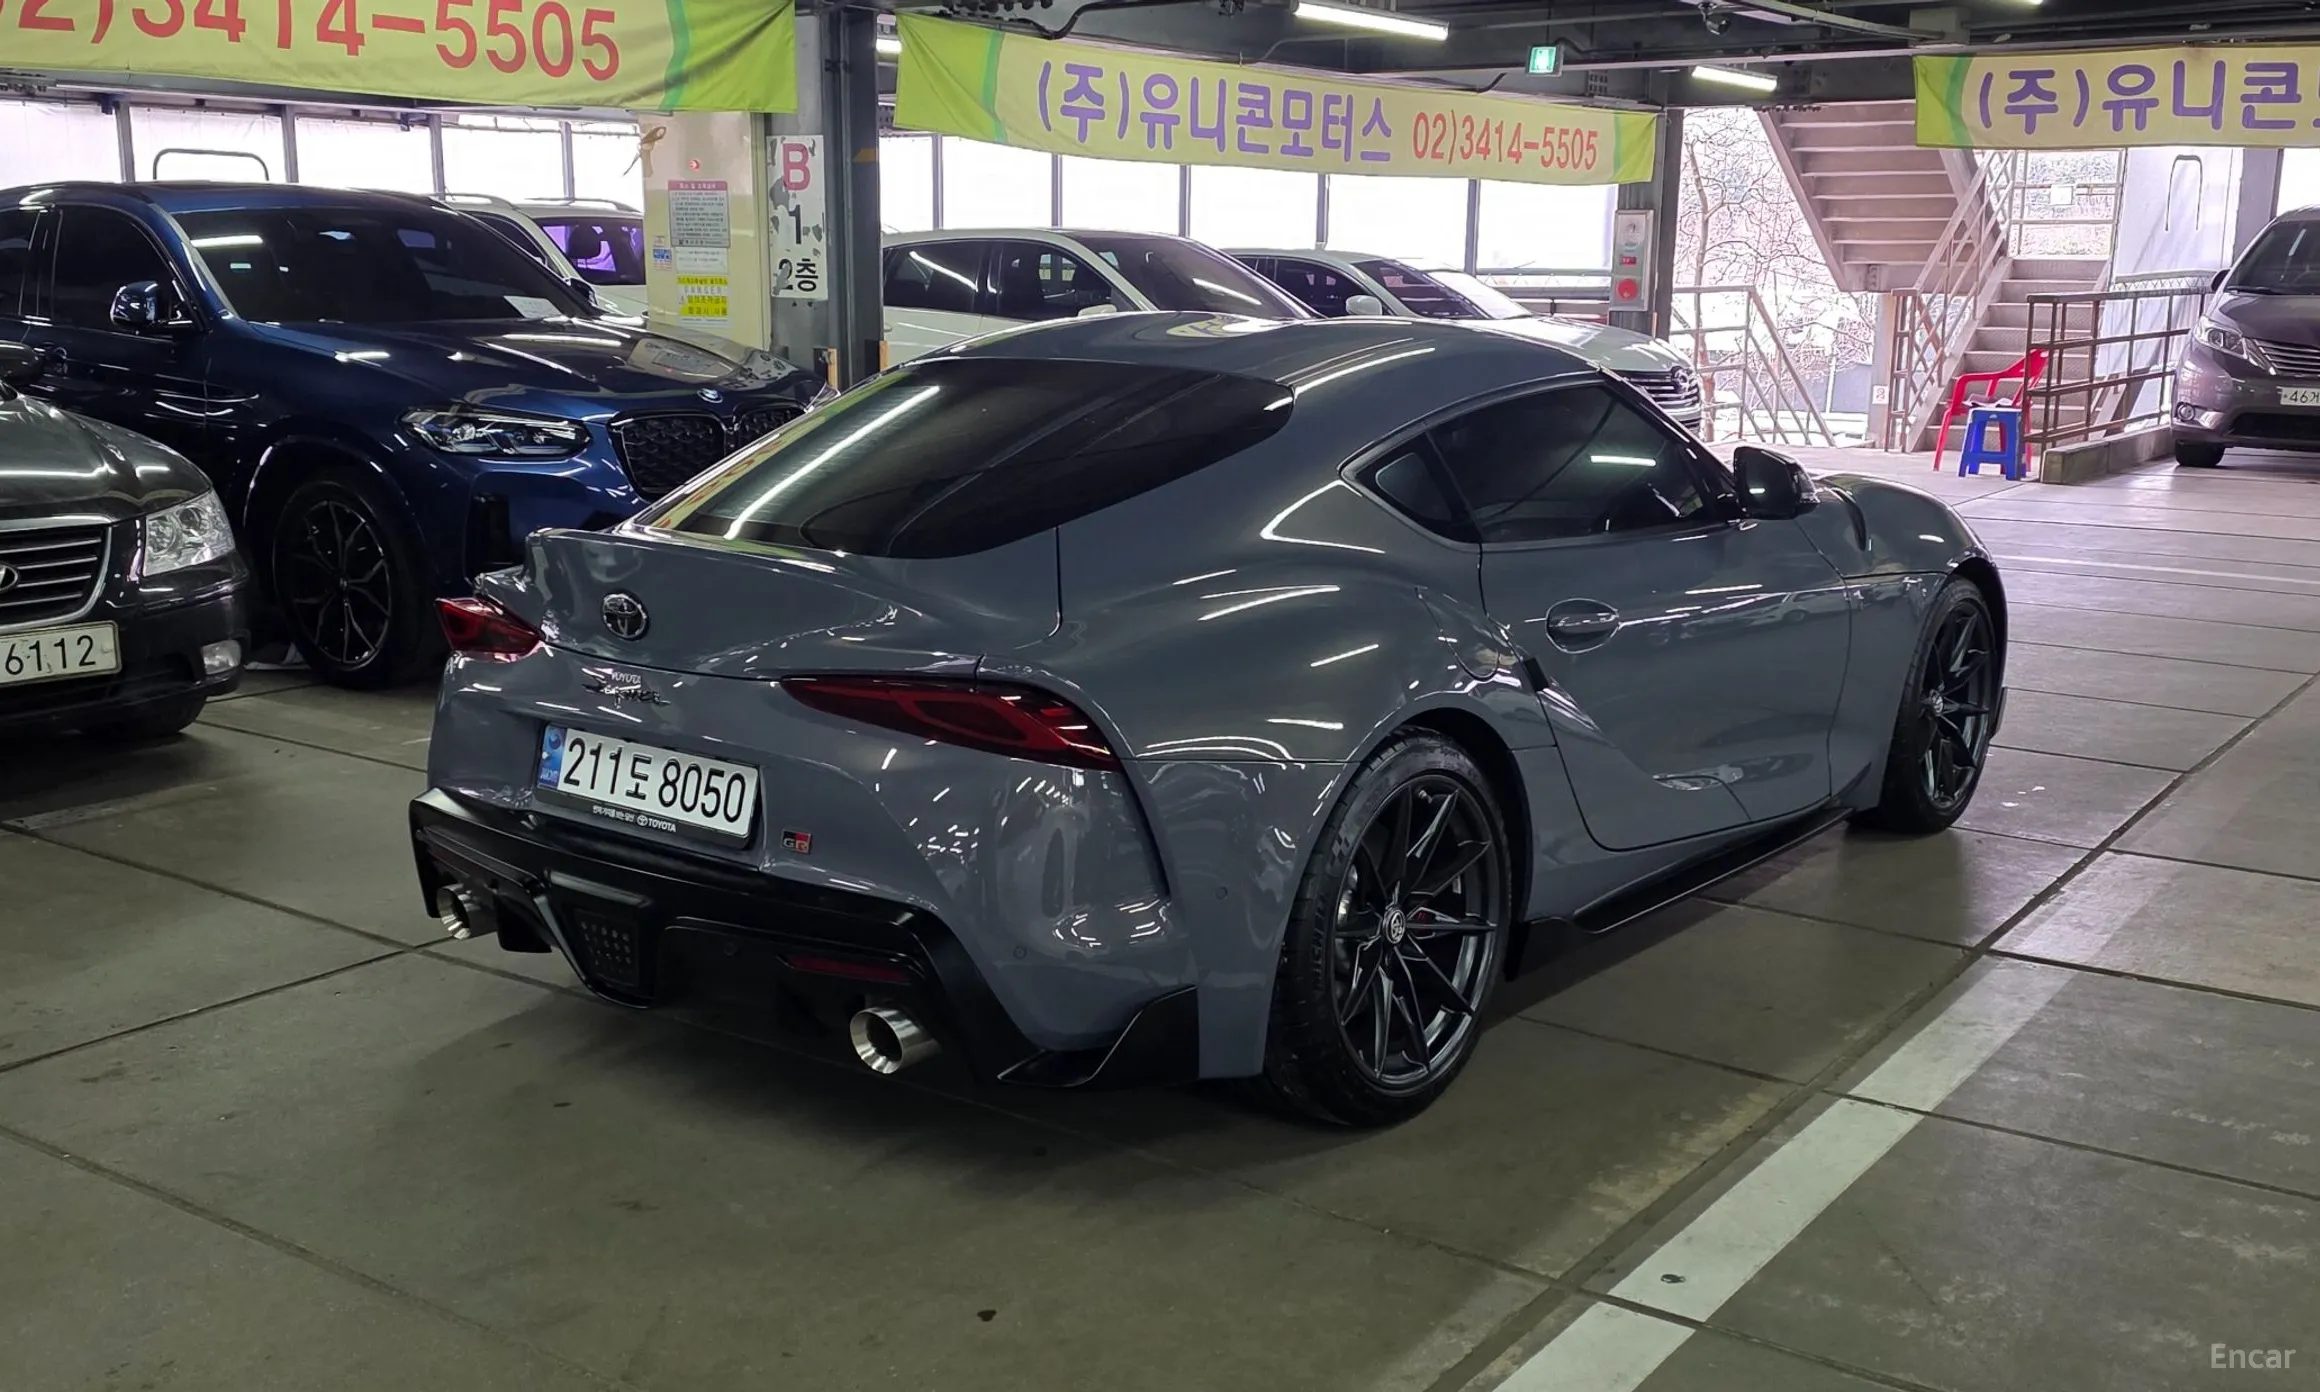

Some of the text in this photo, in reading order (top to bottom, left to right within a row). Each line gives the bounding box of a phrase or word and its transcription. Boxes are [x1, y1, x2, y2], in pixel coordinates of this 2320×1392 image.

[1038, 60, 1598, 170] (주)유니콘모터스 02)3414-5505
[1979, 60, 2320, 135] (주)유니콘
[782, 143, 811, 191] B
[789, 204, 801, 244] 1
[779, 258, 819, 292] 2층
[5, 635, 96, 675] 6112
[564, 738, 747, 823] 211도 8050
[648, 818, 676, 832] TOYOTA
[783, 838, 810, 853] GR
